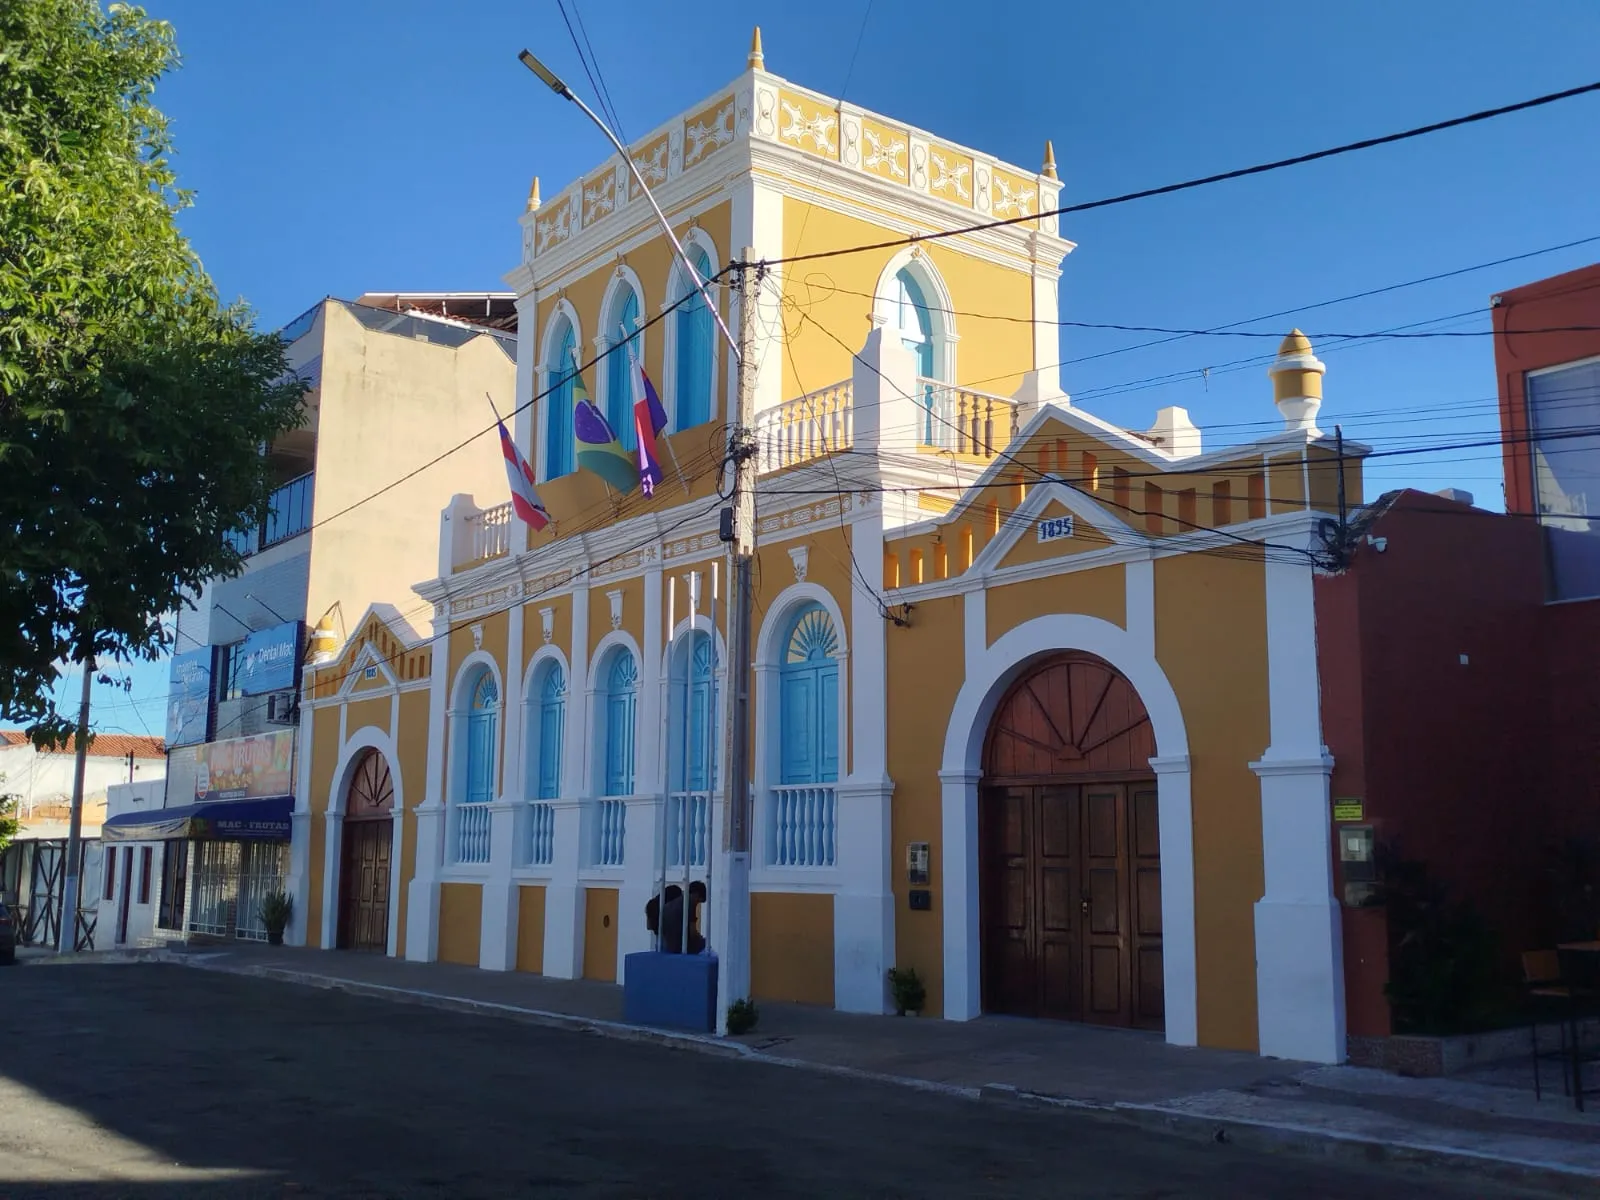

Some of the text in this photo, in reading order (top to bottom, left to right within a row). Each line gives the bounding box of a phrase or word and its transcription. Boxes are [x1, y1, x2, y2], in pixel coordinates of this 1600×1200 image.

[1040, 518, 1071, 540] 1895
[232, 740, 272, 768] FRUTAS
[217, 820, 242, 829] MAC
[249, 821, 289, 830] FRUTAS
